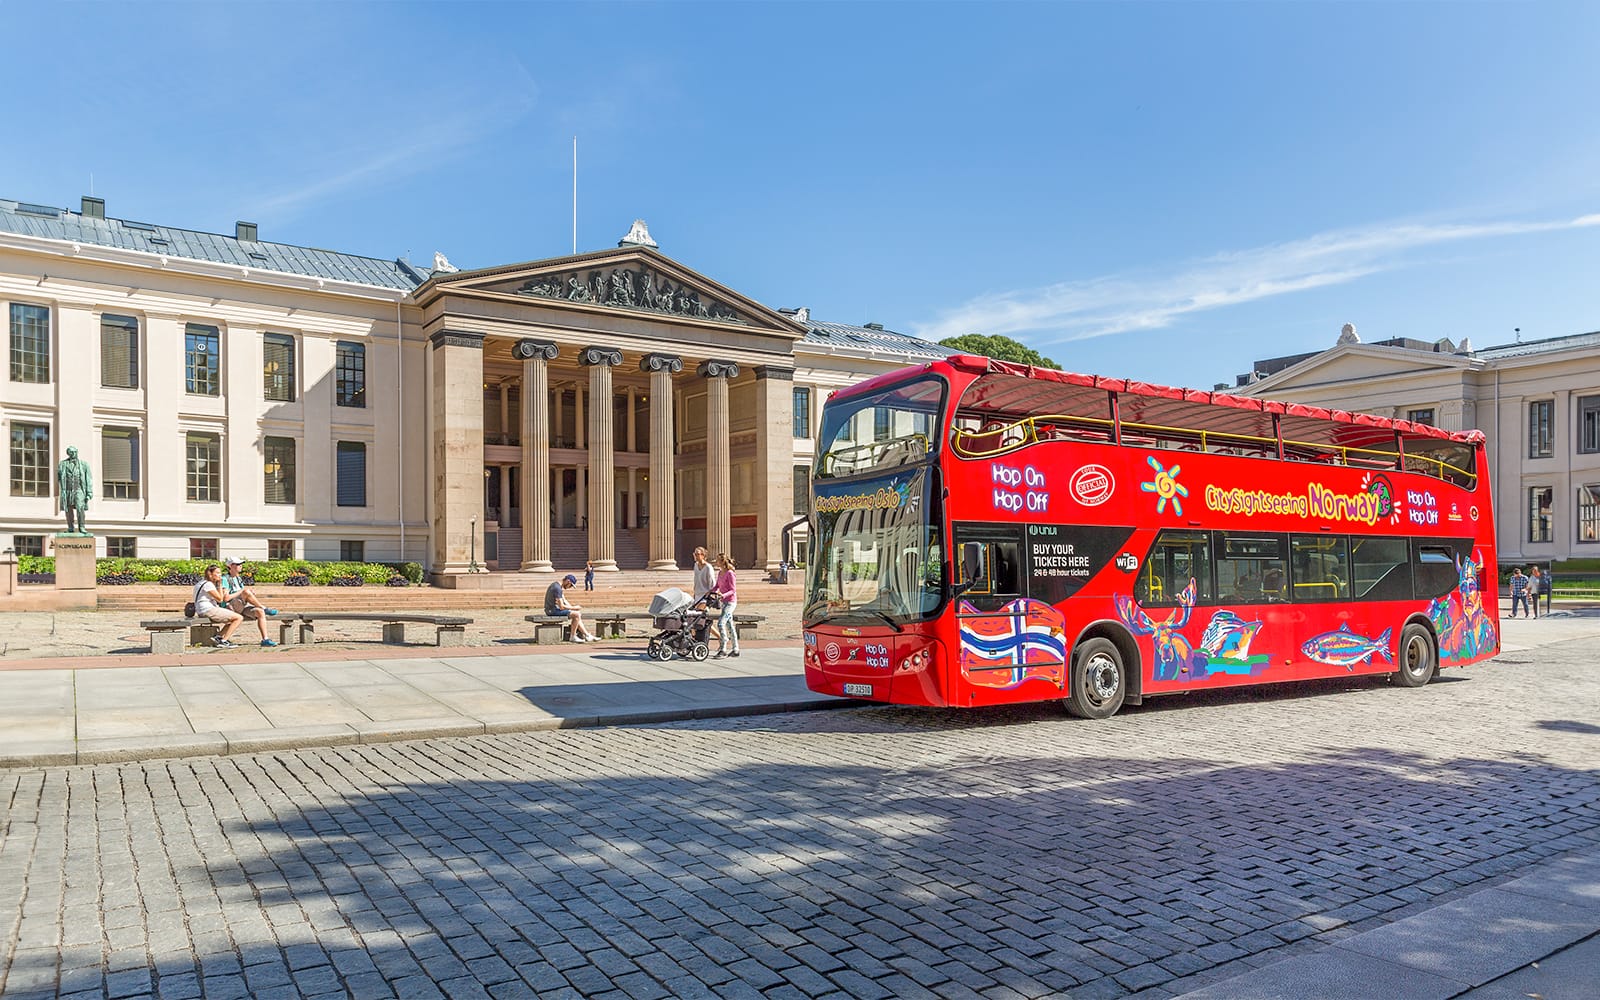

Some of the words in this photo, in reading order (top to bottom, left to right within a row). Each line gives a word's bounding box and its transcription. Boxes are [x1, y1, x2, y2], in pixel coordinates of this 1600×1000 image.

[992, 464, 1022, 487] Hop
[1025, 466, 1046, 487] On
[875, 487, 900, 509] Oslo
[994, 489, 1023, 512] Hop
[1026, 491, 1049, 511] Off
[1308, 482, 1379, 526] Norway
[1407, 490, 1424, 506] Hop
[1424, 491, 1436, 506] On
[1409, 509, 1426, 525] Hop
[1426, 510, 1439, 524] Off
[1033, 544, 1050, 555] BUY
[1051, 544, 1074, 555] YOUR
[1033, 556, 1067, 567] TICKETS
[1068, 556, 1090, 567] HERE
[1057, 568, 1070, 576] hour
[1070, 568, 1090, 576] tickets
[865, 643, 878, 655] Hop
[878, 643, 888, 655] On
[866, 656, 879, 668] Hop
[879, 656, 889, 668] Off
